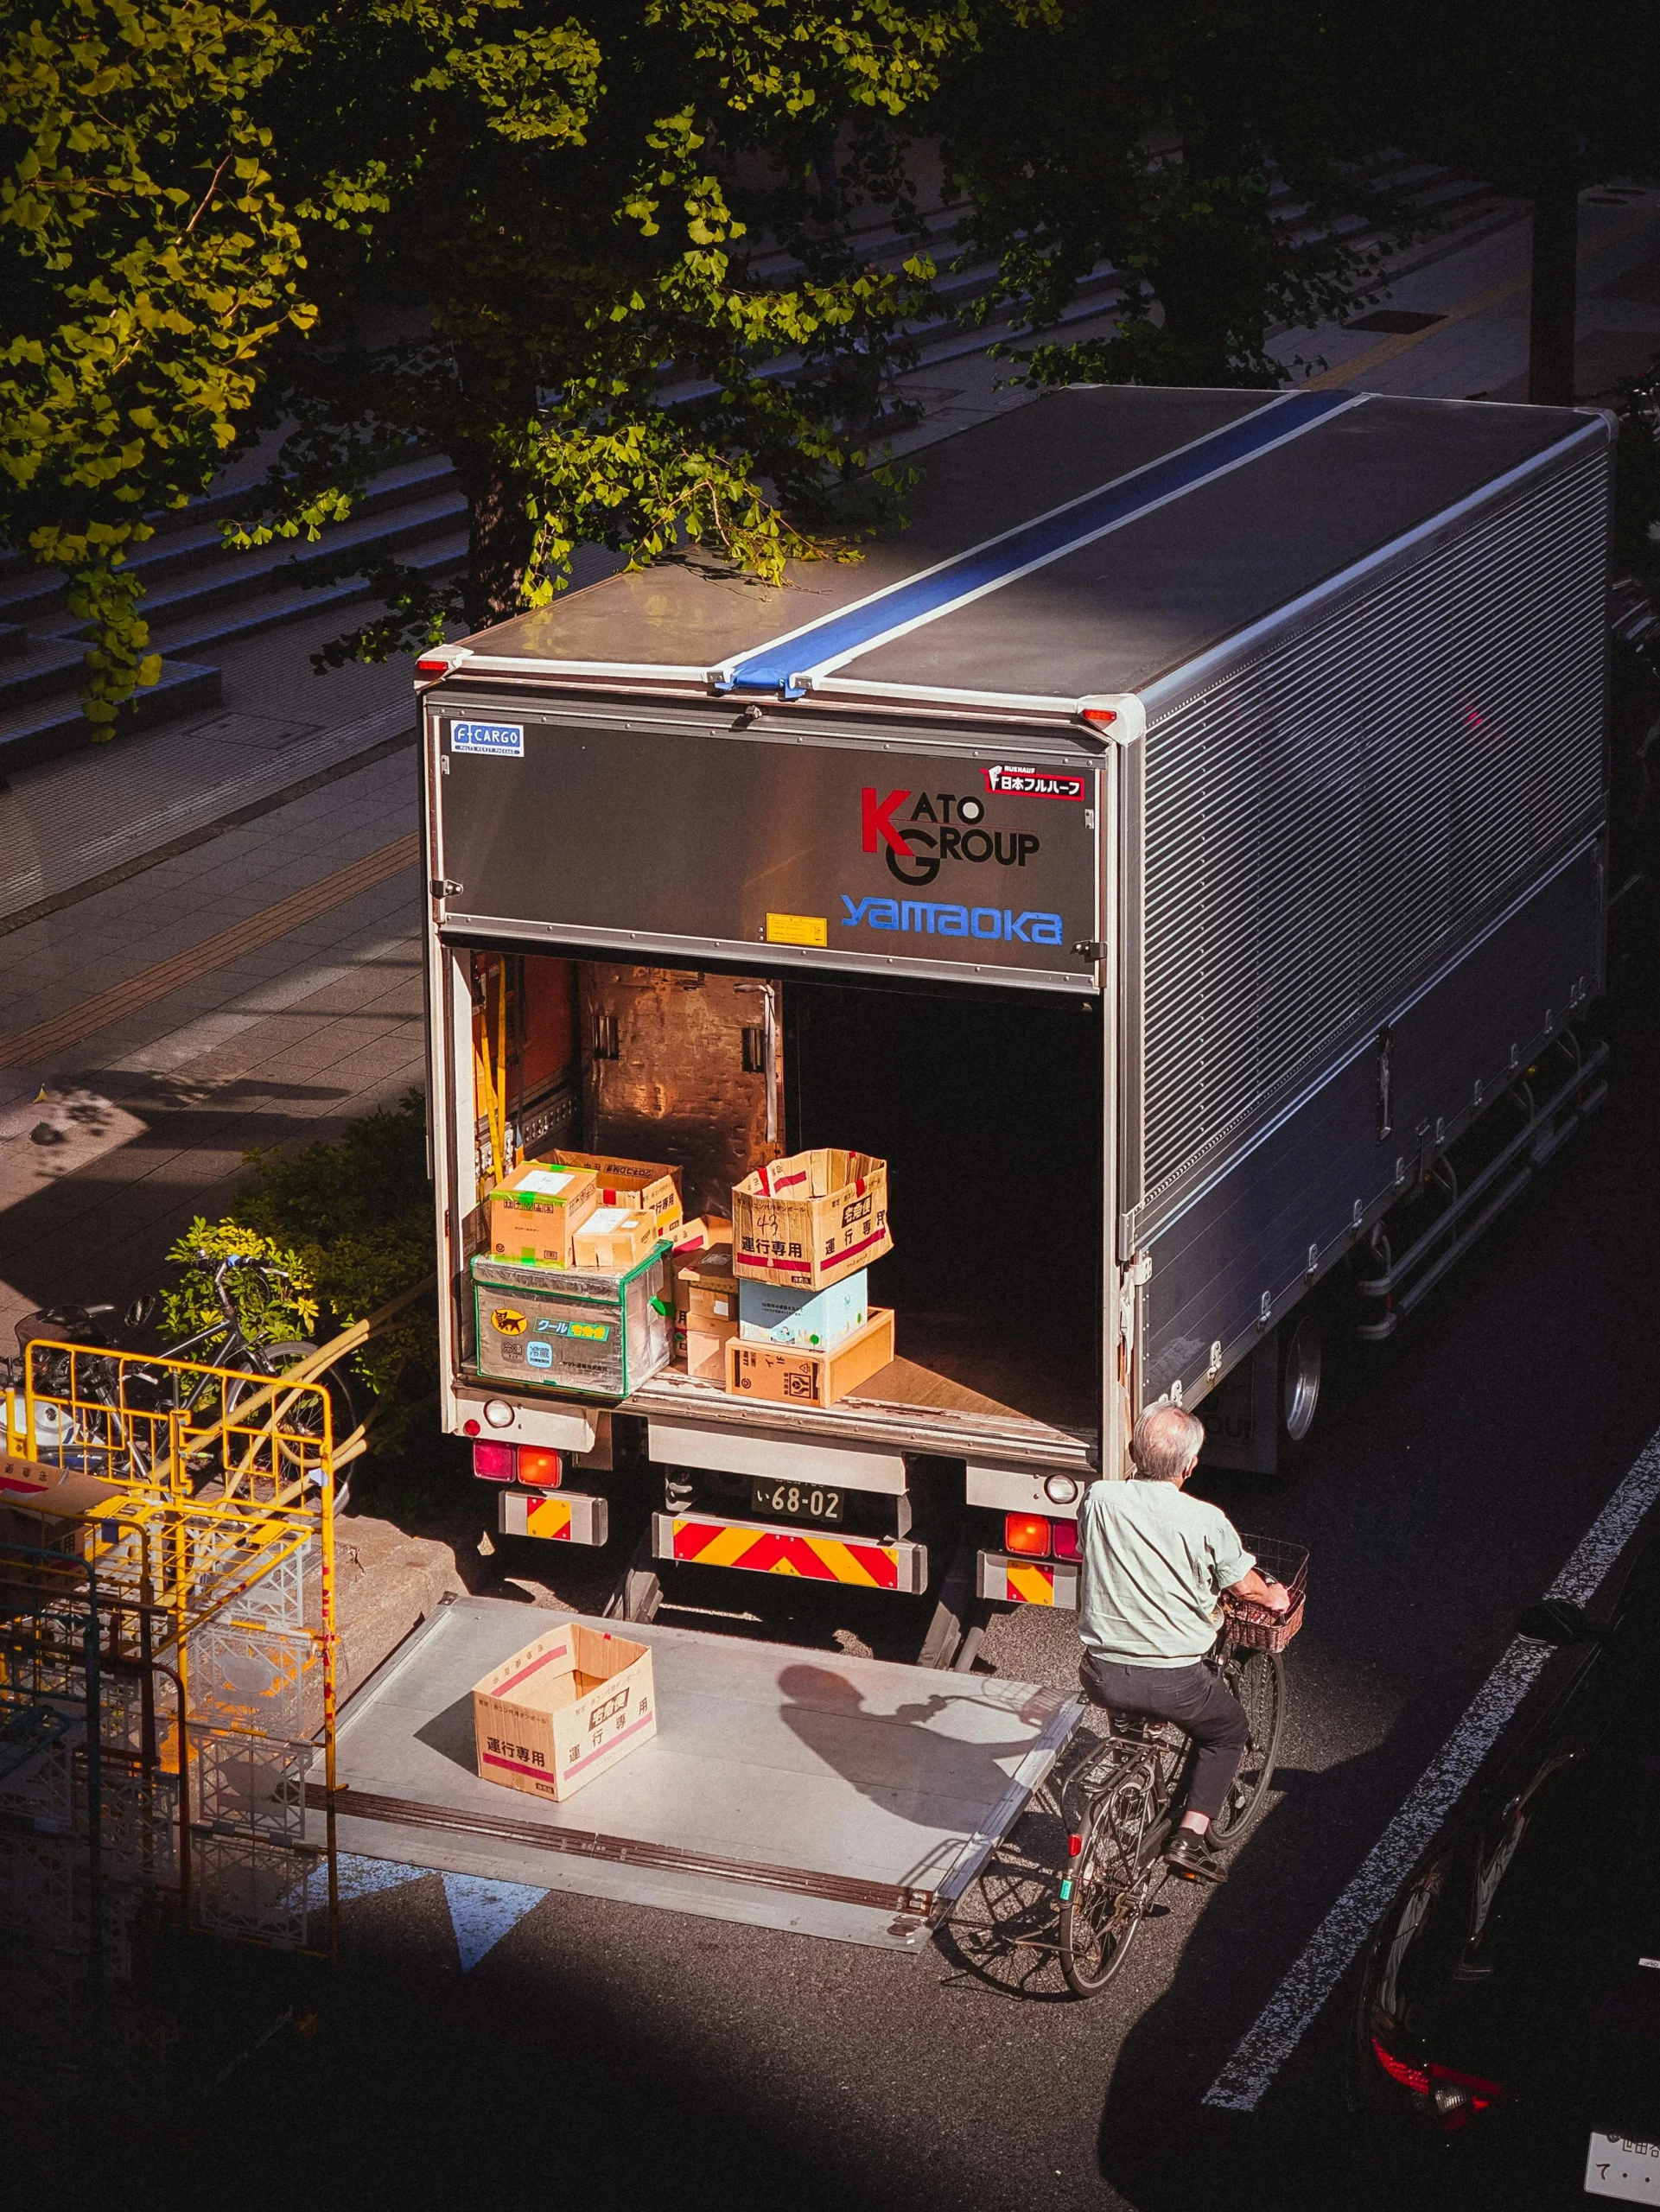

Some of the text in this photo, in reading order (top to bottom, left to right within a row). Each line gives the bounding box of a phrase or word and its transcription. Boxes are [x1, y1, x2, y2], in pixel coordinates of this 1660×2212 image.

[1002, 776, 1080, 795] 日本フルハーフ
[862, 787, 984, 857] KATO
[886, 827, 1040, 887] GROUP
[841, 895, 1063, 945] yamaoka
[757, 1214, 779, 1236] 43
[844, 1196, 871, 1223] 宅急便
[742, 1236, 802, 1258] 運行専用
[826, 1210, 885, 1255] 運行専用
[757, 1485, 839, 1518] い 68-02
[591, 1691, 626, 1727] 宅急便
[569, 1696, 648, 1764] 運行専用
[487, 1736, 545, 1768] 運行専用
[1595, 2163, 1611, 2180] て
